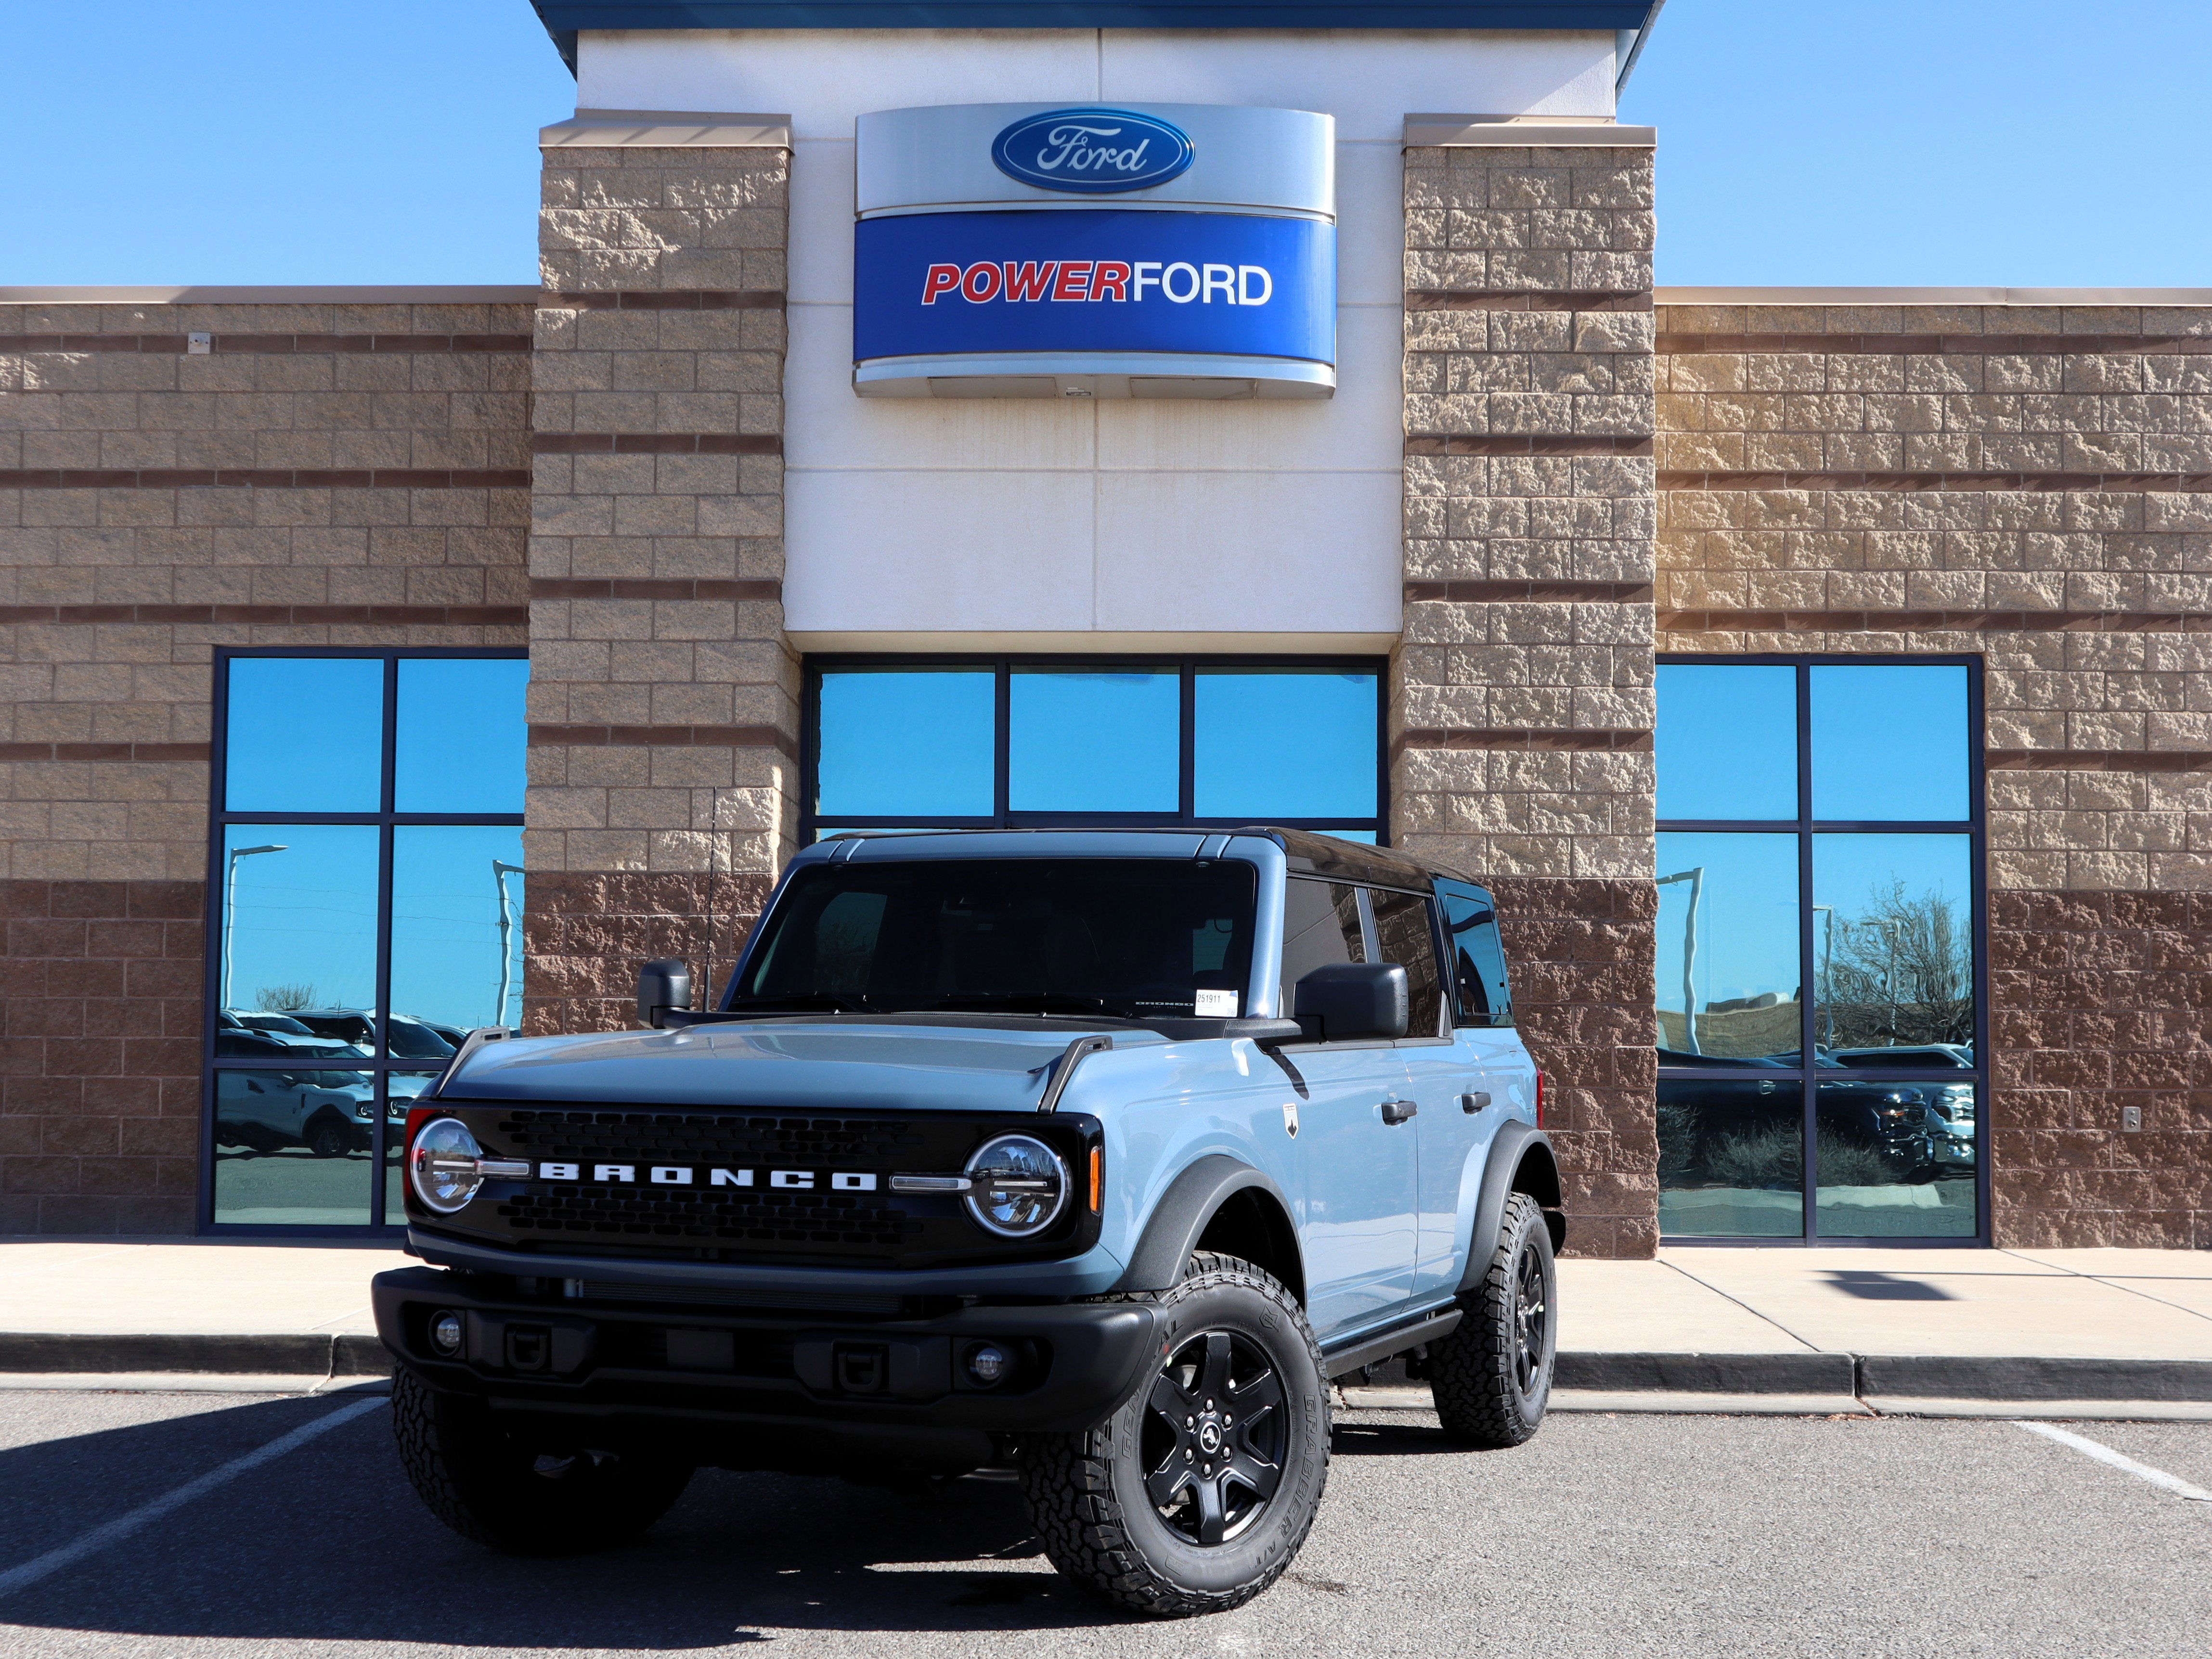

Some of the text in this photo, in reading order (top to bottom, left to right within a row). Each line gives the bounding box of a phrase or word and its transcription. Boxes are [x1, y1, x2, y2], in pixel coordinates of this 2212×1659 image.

[1036, 124, 1150, 172] Ford
[1197, 994, 1221, 1003] 251911
[539, 1162, 877, 1191] BRONCO
[1278, 1393, 1318, 1539] GRABBER
